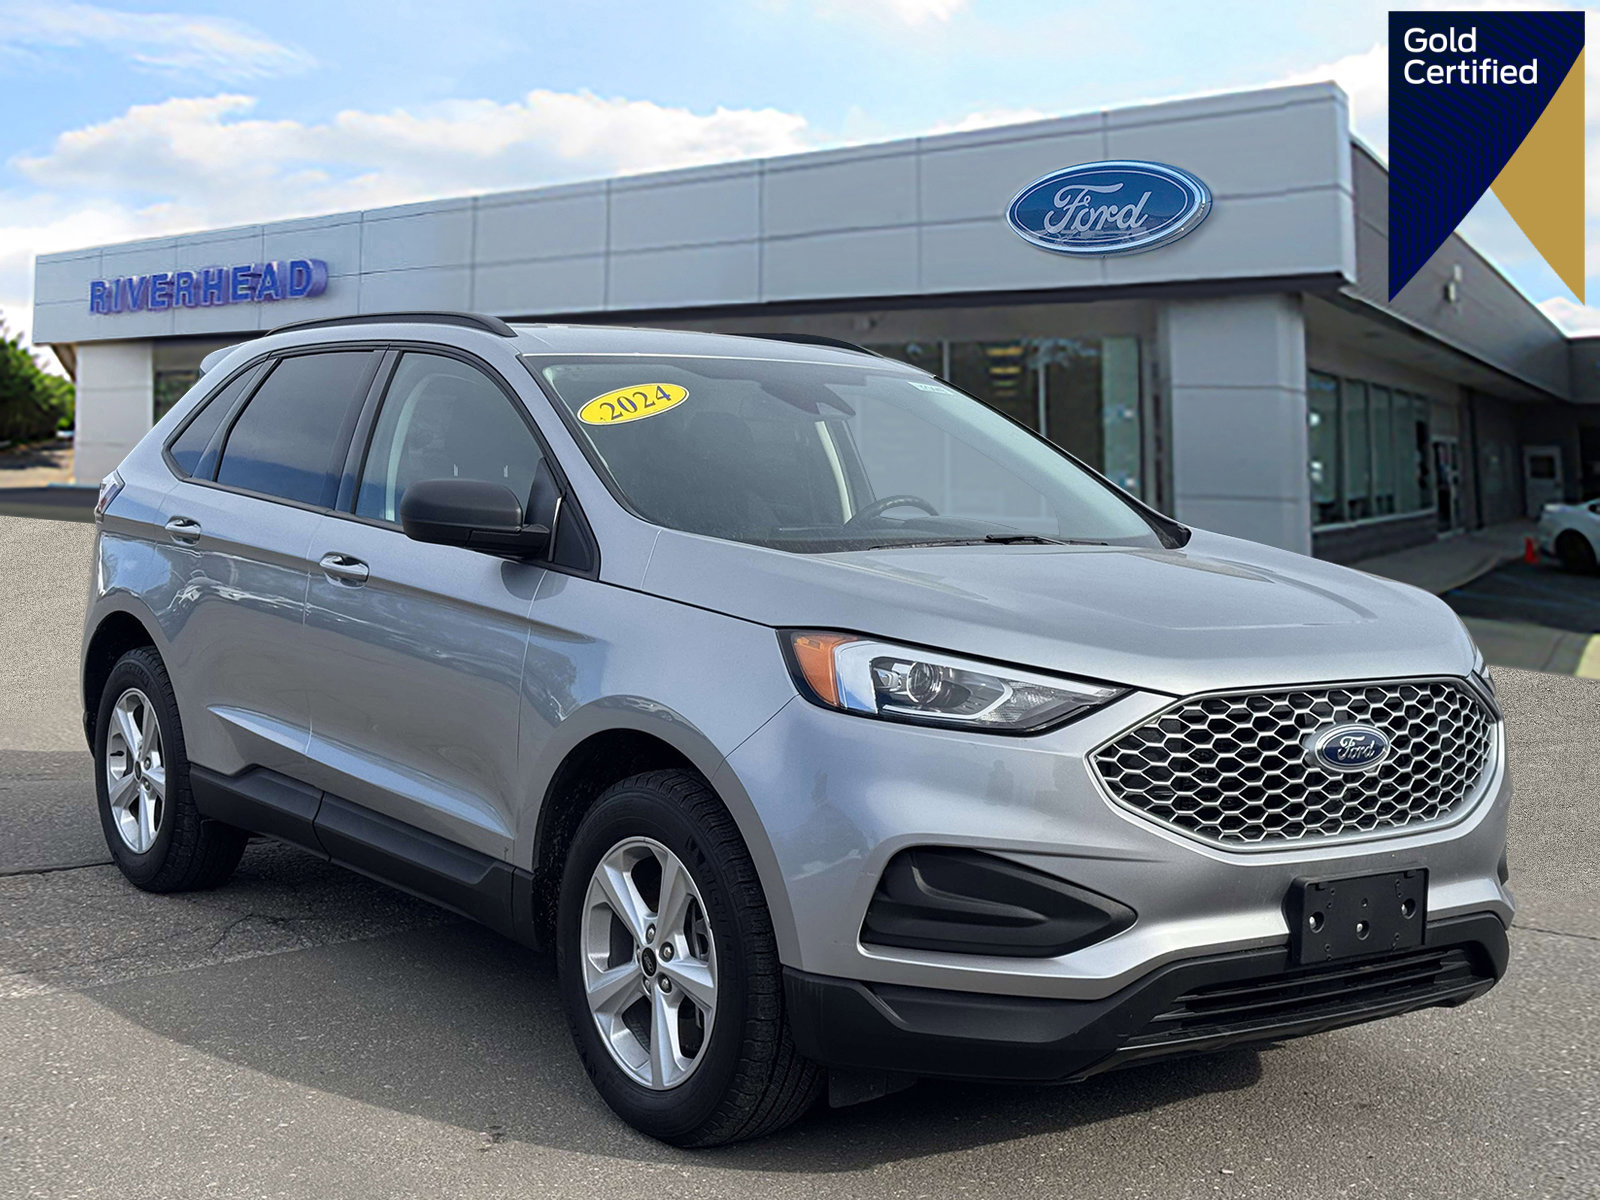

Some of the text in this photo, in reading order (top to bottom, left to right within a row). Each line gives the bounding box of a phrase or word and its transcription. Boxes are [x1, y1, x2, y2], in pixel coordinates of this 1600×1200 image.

[1043, 182, 1153, 234] Ford
[89, 259, 316, 315] RIVERHEAD
[599, 385, 672, 421] 2024
[1337, 735, 1376, 761] Ford
